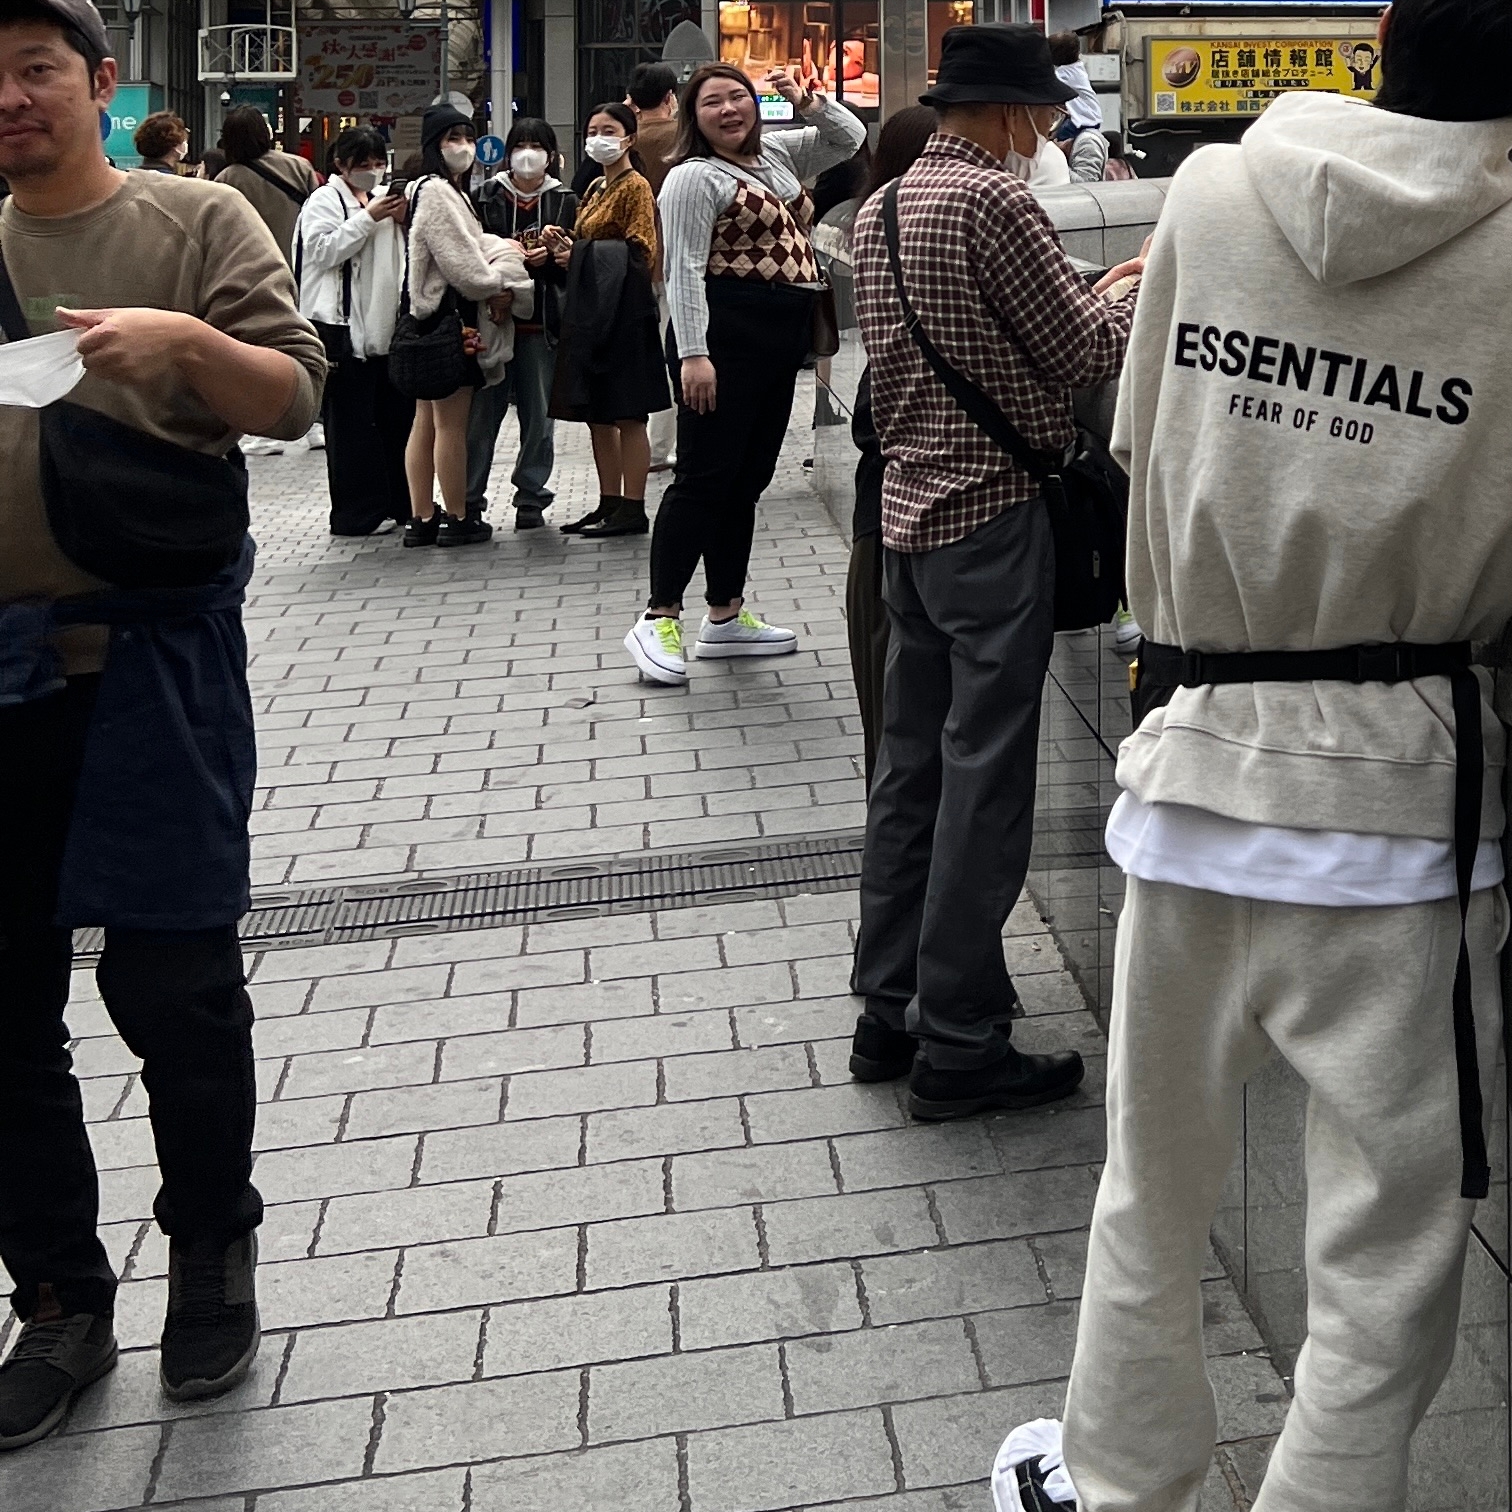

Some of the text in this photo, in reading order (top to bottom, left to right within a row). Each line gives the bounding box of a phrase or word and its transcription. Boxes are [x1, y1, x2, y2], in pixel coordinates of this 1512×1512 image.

[1210, 41, 1241, 49] KANSAI
[1275, 41, 1334, 49] CORPORATION
[1211, 48, 1334, 68] 店舗情報館
[1174, 322, 1473, 425] ESSENTIALS
[1228, 394, 1374, 445] FEAR OF GOD
